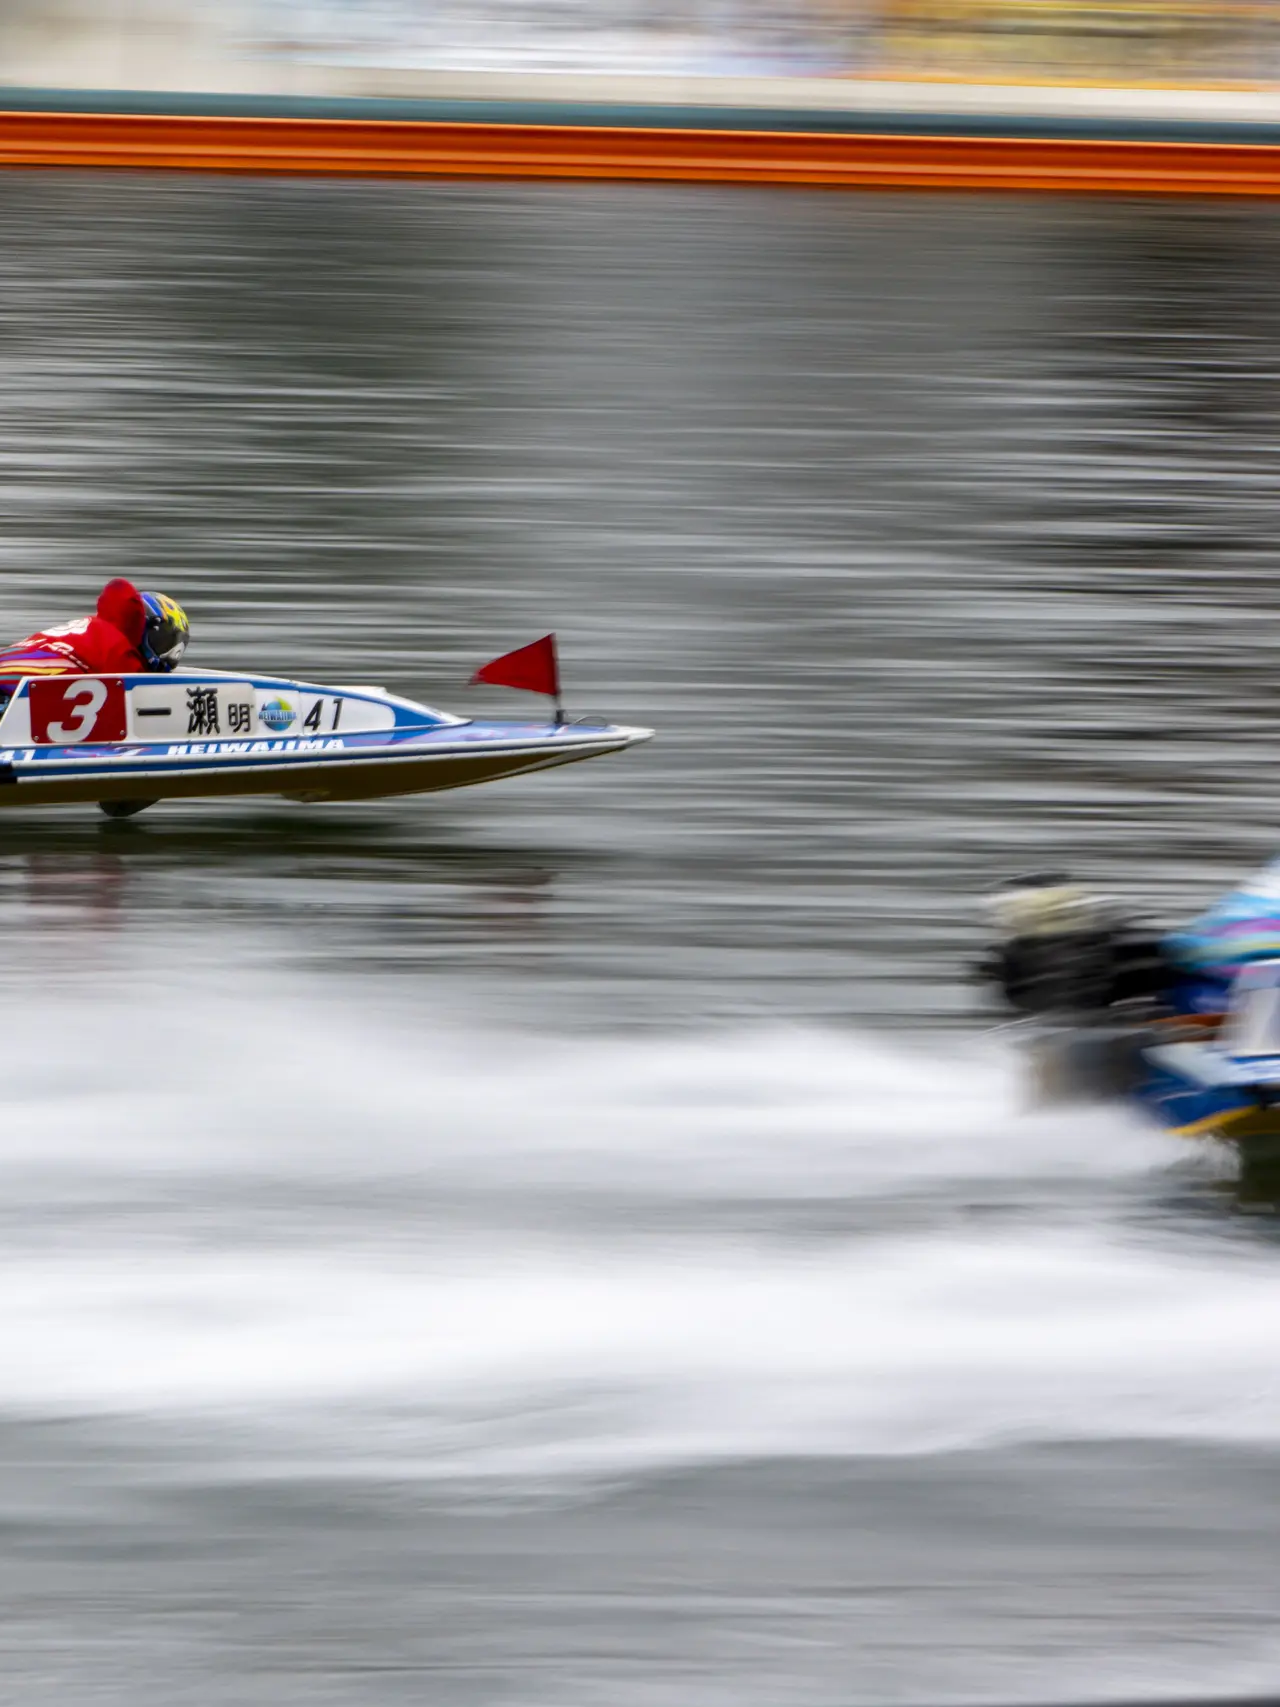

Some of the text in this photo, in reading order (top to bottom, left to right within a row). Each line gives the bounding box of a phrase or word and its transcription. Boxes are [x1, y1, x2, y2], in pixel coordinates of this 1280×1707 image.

[46, 678, 108, 743] 3
[303, 698, 345, 731] 41
[167, 738, 346, 756] HEIWAJIMA
